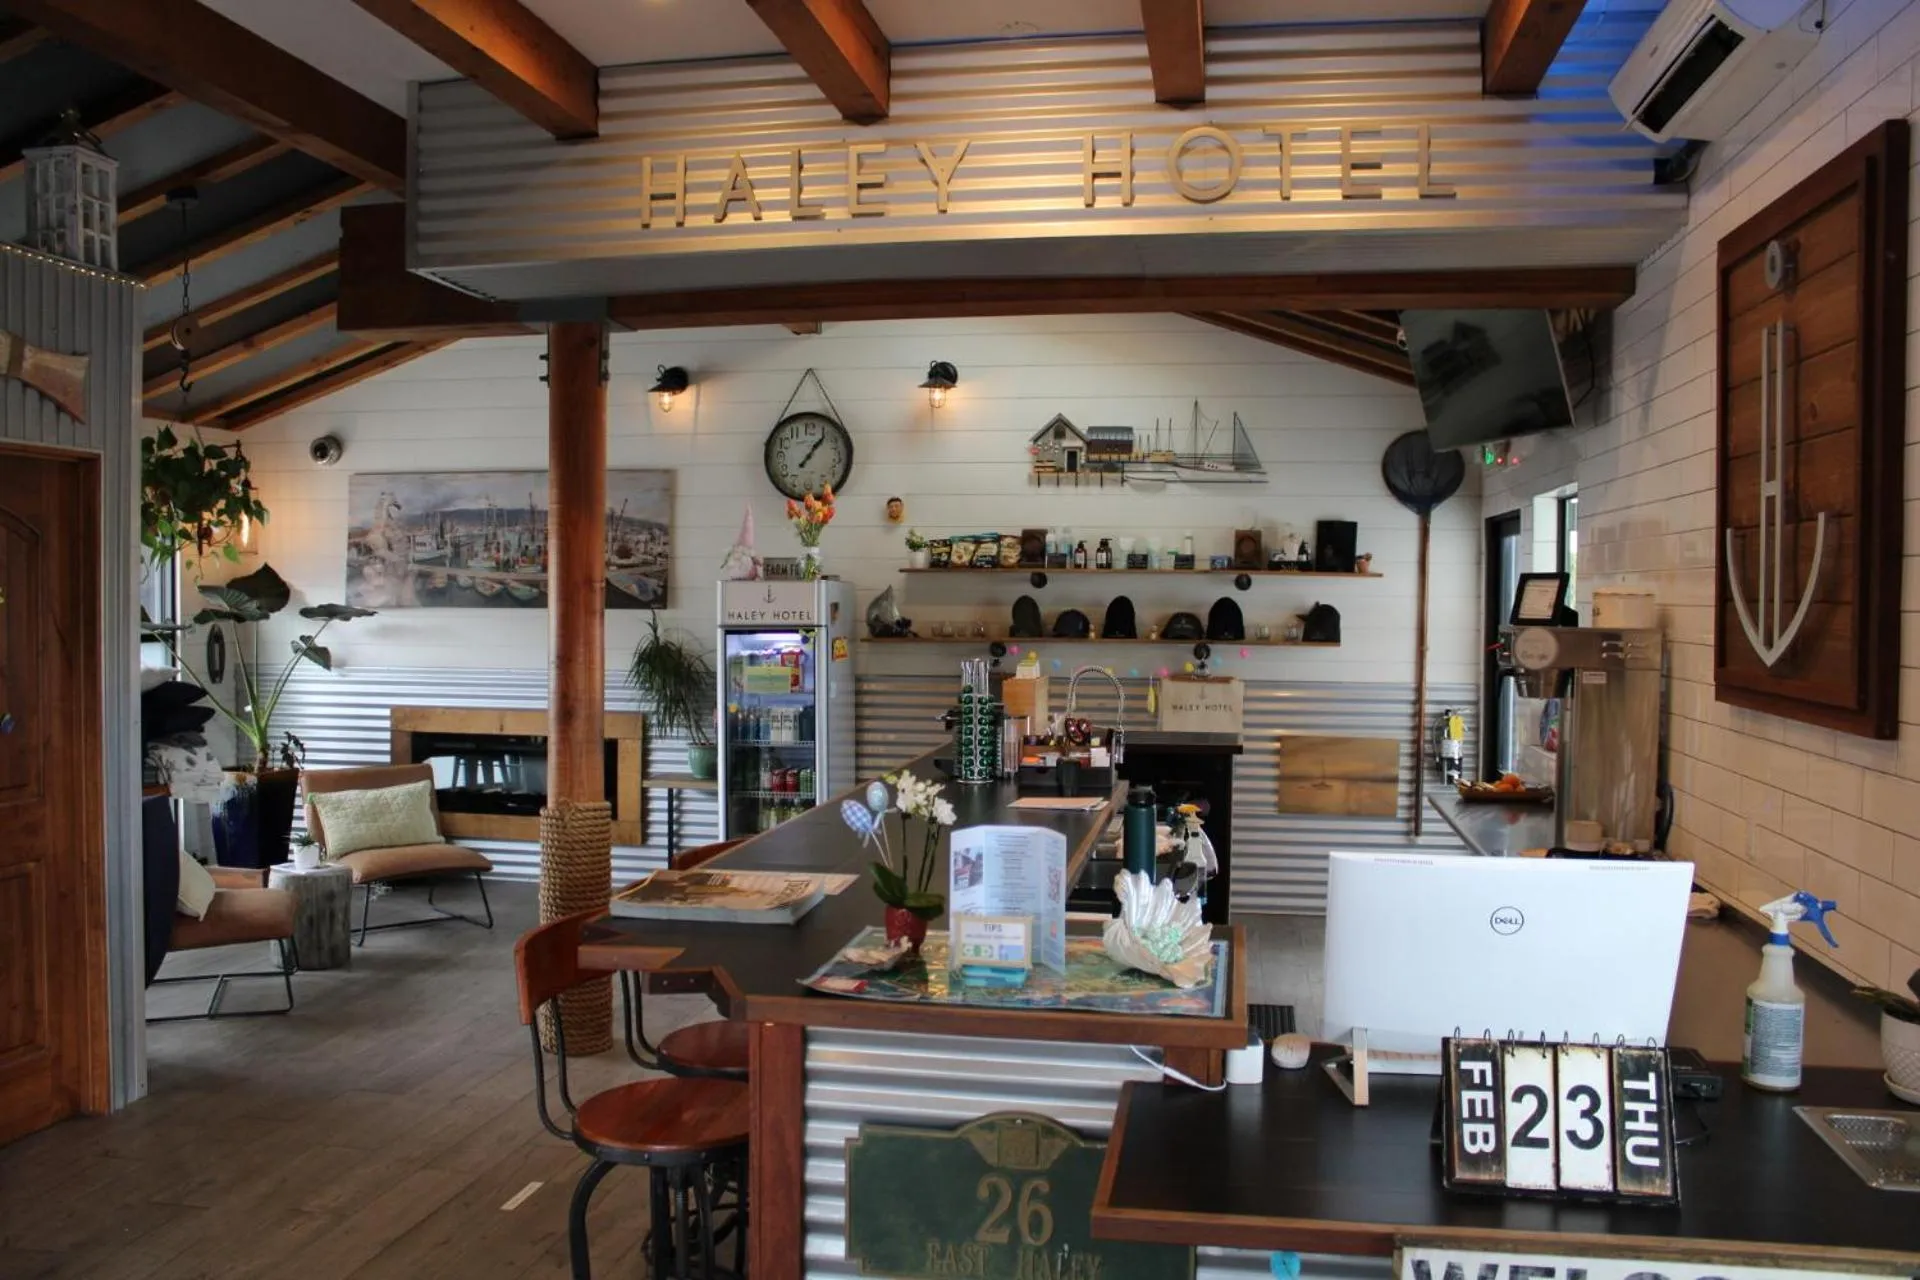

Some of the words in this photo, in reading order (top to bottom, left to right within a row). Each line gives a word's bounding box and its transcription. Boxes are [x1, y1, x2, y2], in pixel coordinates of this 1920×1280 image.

[641, 139, 971, 228] HALEY
[1083, 124, 1457, 207] HOTEL
[765, 563, 788, 577] FARM
[728, 610, 765, 620] HALEY
[773, 610, 811, 620] HOTEL
[1172, 704, 1200, 712] HALEY
[1205, 704, 1233, 712] HOTEL
[984, 923, 1003, 932] TIPS
[1494, 917, 1520, 925] DELL
[1460, 1061, 1496, 1154] FEB
[1623, 1072, 1660, 1167] THU
[976, 1175, 1053, 1245] 26
[926, 1240, 989, 1276] EAST
